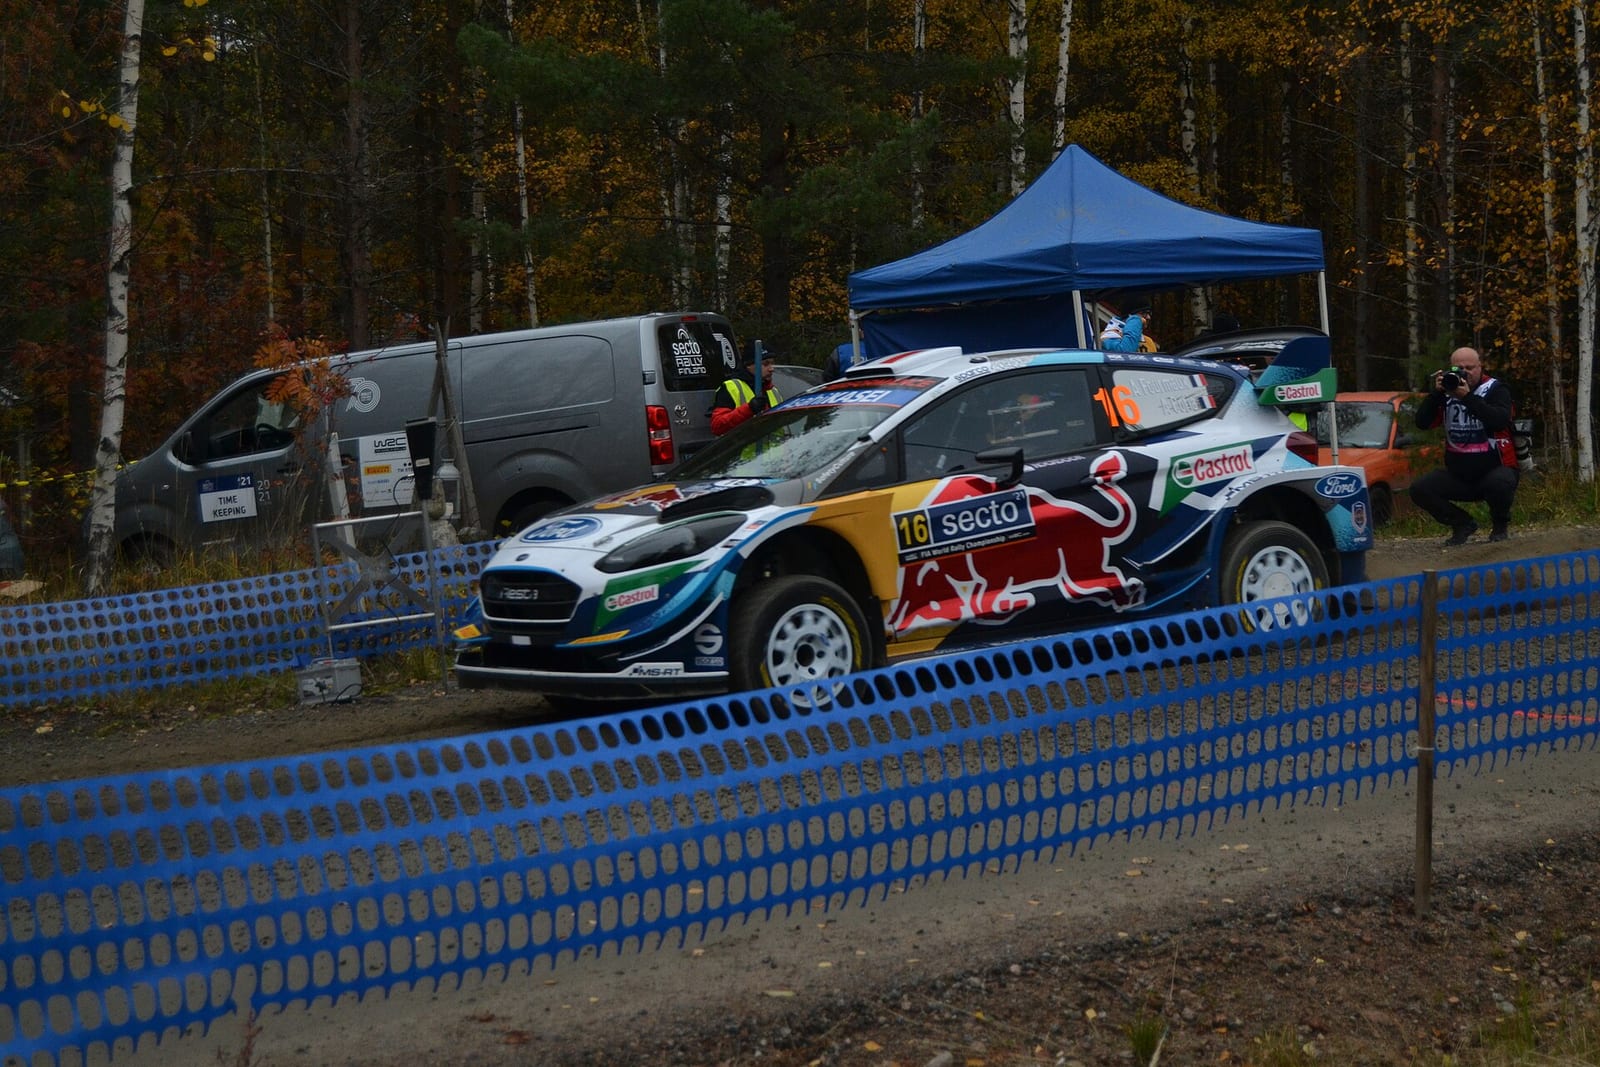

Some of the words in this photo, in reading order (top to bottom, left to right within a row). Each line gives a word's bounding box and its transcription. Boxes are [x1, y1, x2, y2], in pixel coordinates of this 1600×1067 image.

[672, 342, 701, 355] secto
[1284, 385, 1319, 400] Castrol
[1093, 385, 1142, 428] 16
[374, 437, 407, 448] WRC
[1194, 449, 1253, 482] Castrol
[1323, 475, 1356, 495] Ford
[218, 495, 238, 505] TIME
[213, 506, 246, 519] KEEPING
[899, 514, 929, 546] 16
[941, 500, 1019, 536] secto
[617, 587, 656, 607] Castrol
